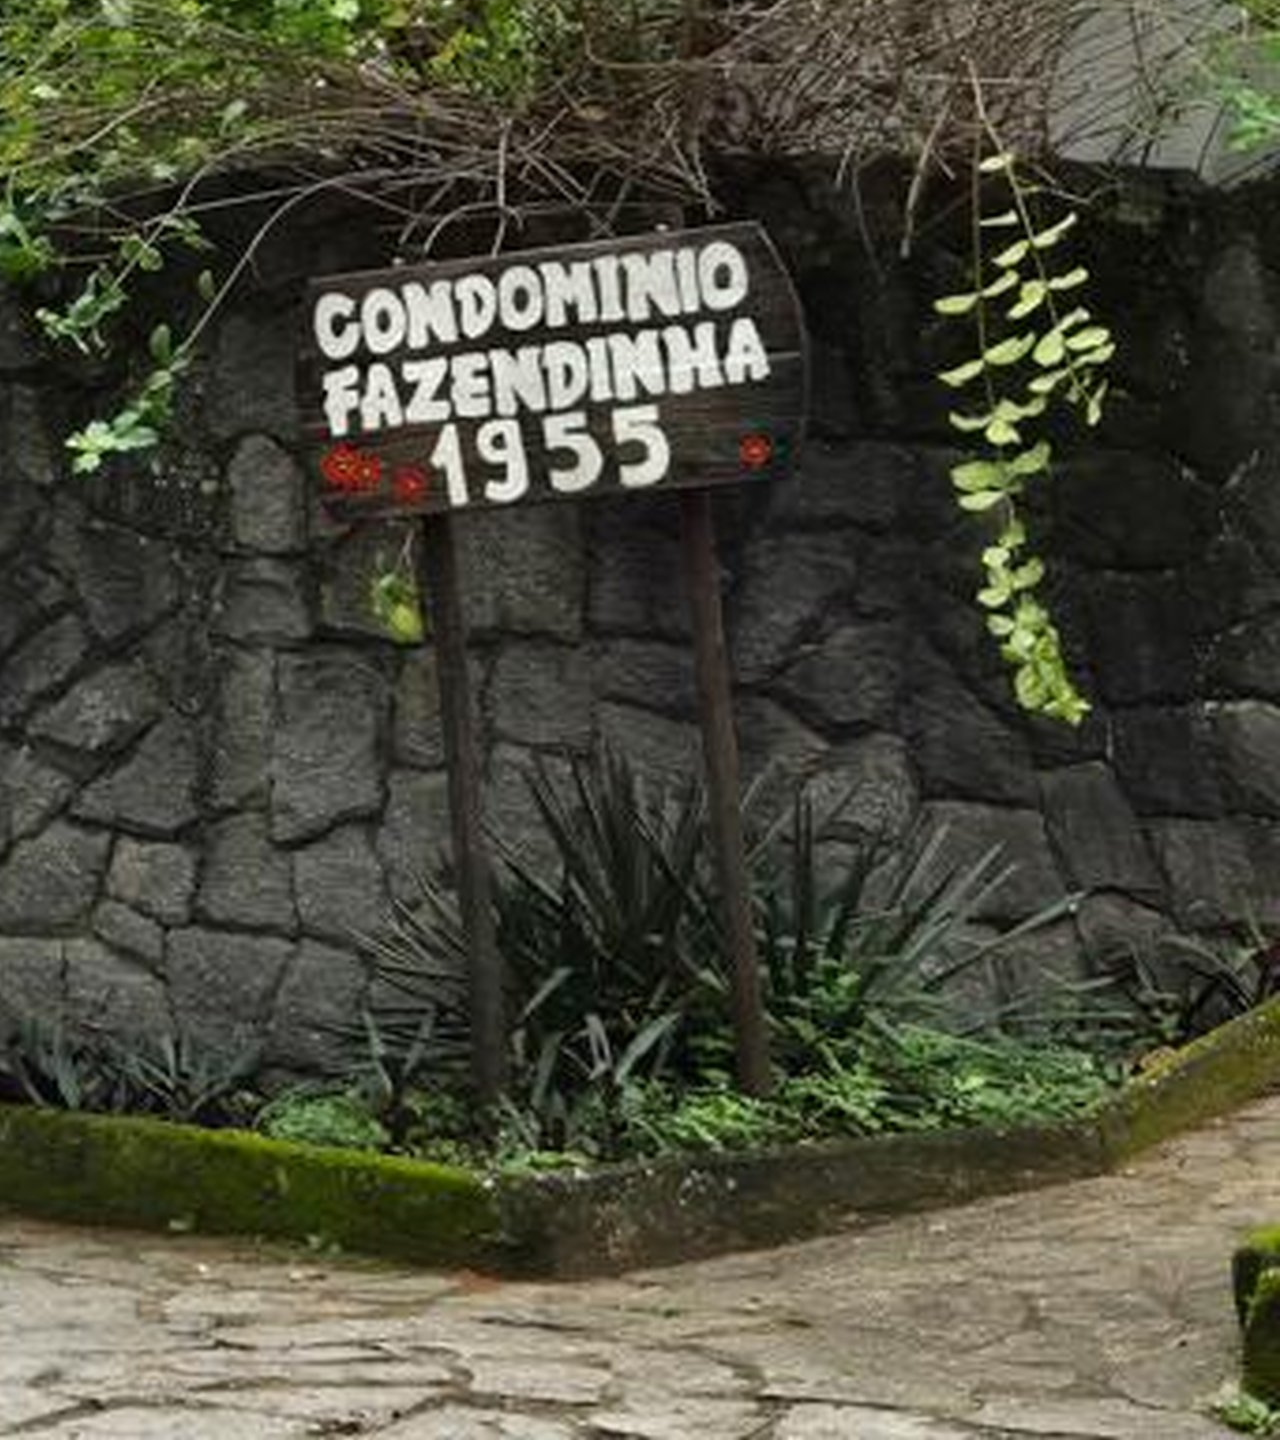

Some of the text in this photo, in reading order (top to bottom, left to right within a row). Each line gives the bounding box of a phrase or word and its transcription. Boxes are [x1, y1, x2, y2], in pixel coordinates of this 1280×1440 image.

[314, 241, 748, 359] CONDOMINIO
[323, 318, 770, 436] FAZENDINHA
[430, 405, 671, 506] 1955
